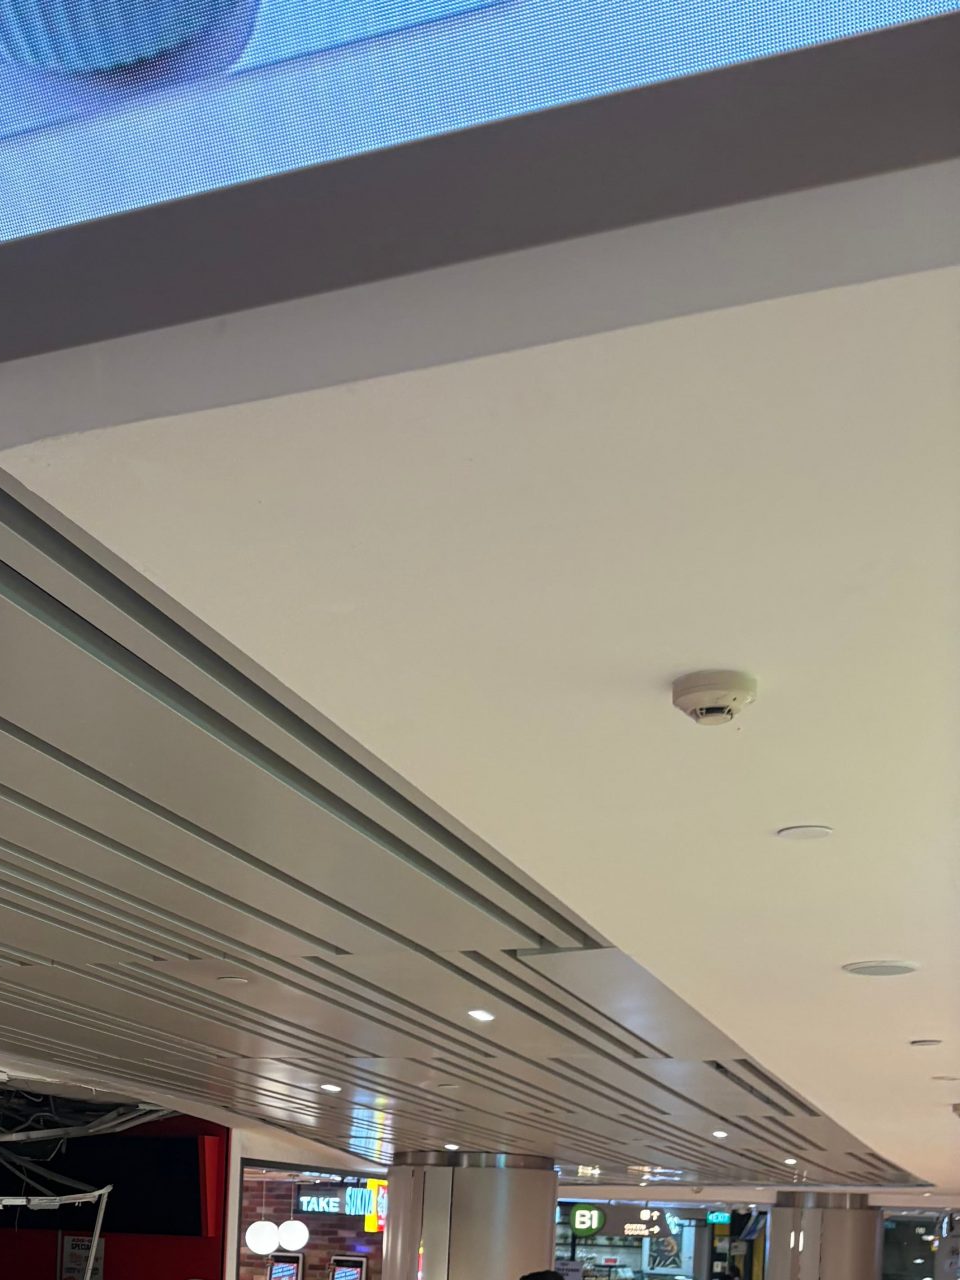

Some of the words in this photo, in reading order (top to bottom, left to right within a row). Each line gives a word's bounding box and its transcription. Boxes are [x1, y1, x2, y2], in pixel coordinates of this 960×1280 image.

[300, 1196, 340, 1213] TAKE
[345, 1186, 373, 1216] SUKIYA
[574, 1209, 599, 1230] B1
